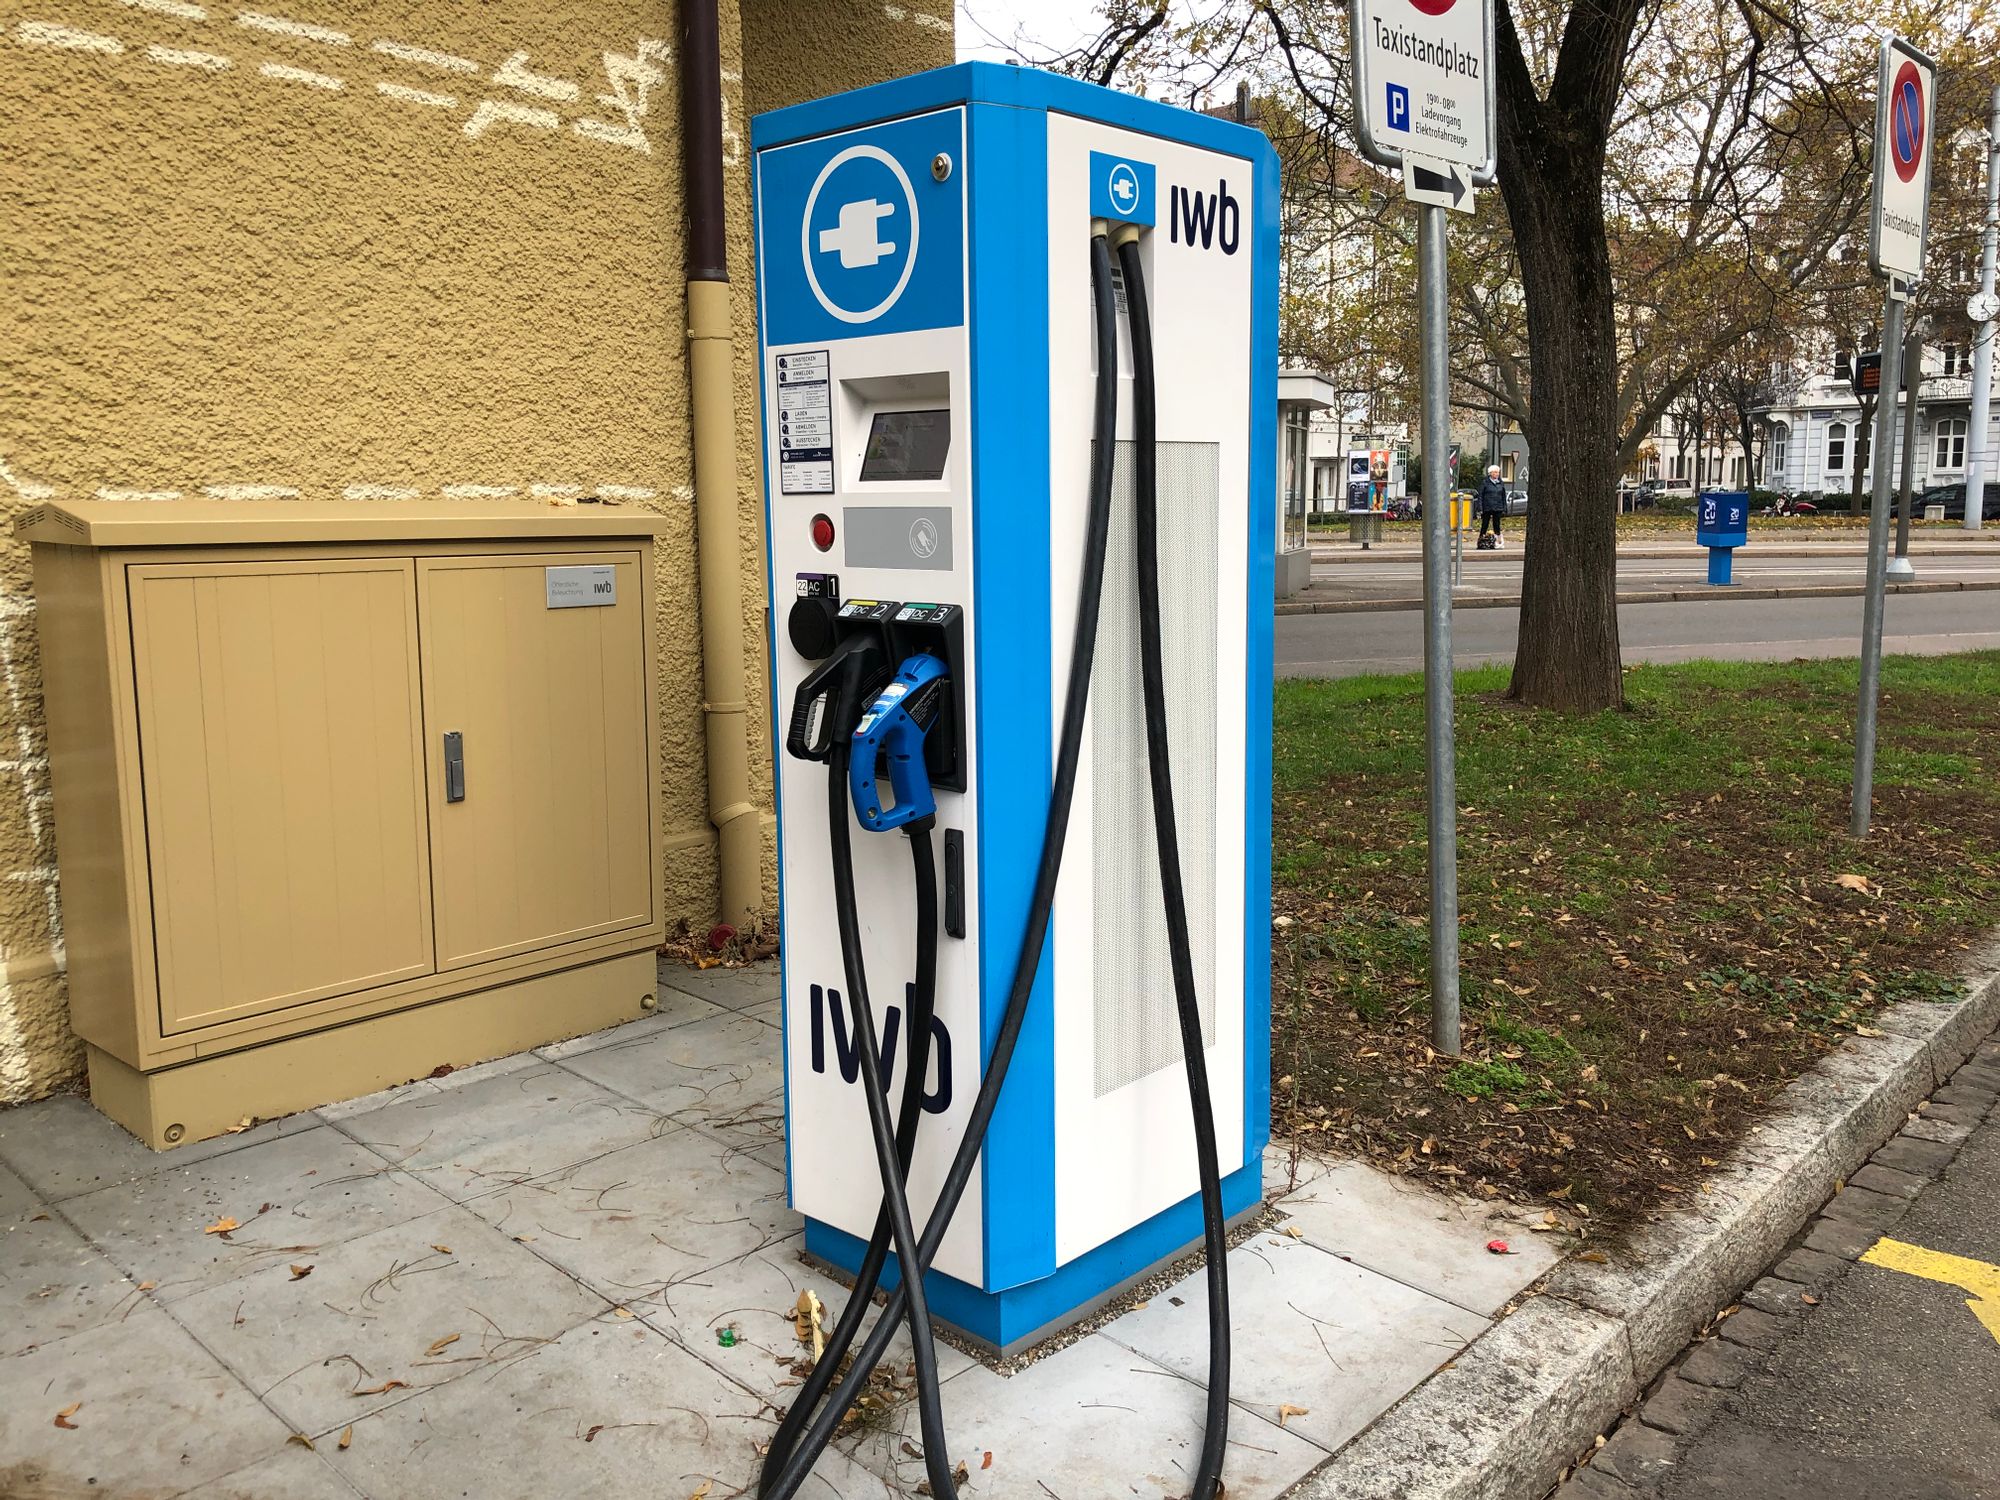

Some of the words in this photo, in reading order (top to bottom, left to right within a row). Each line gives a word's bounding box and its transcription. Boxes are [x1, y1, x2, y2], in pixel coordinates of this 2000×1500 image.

[1373, 16, 1479, 79] Taxistandplatz
[1392, 91, 1404, 124] P
[1421, 105, 1462, 130] Ladevorgang
[1415, 121, 1468, 148] Elektrofahrzeuge
[1882, 207, 1920, 239] Taxistandplatz
[1704, 501, 1716, 520] 20
[798, 581, 807, 591] 22
[808, 581, 820, 592] AC
[830, 577, 836, 596] 1
[854, 606, 869, 615] DC
[872, 604, 888, 617] 2
[912, 610, 928, 618] DC
[932, 607, 948, 621] 3
